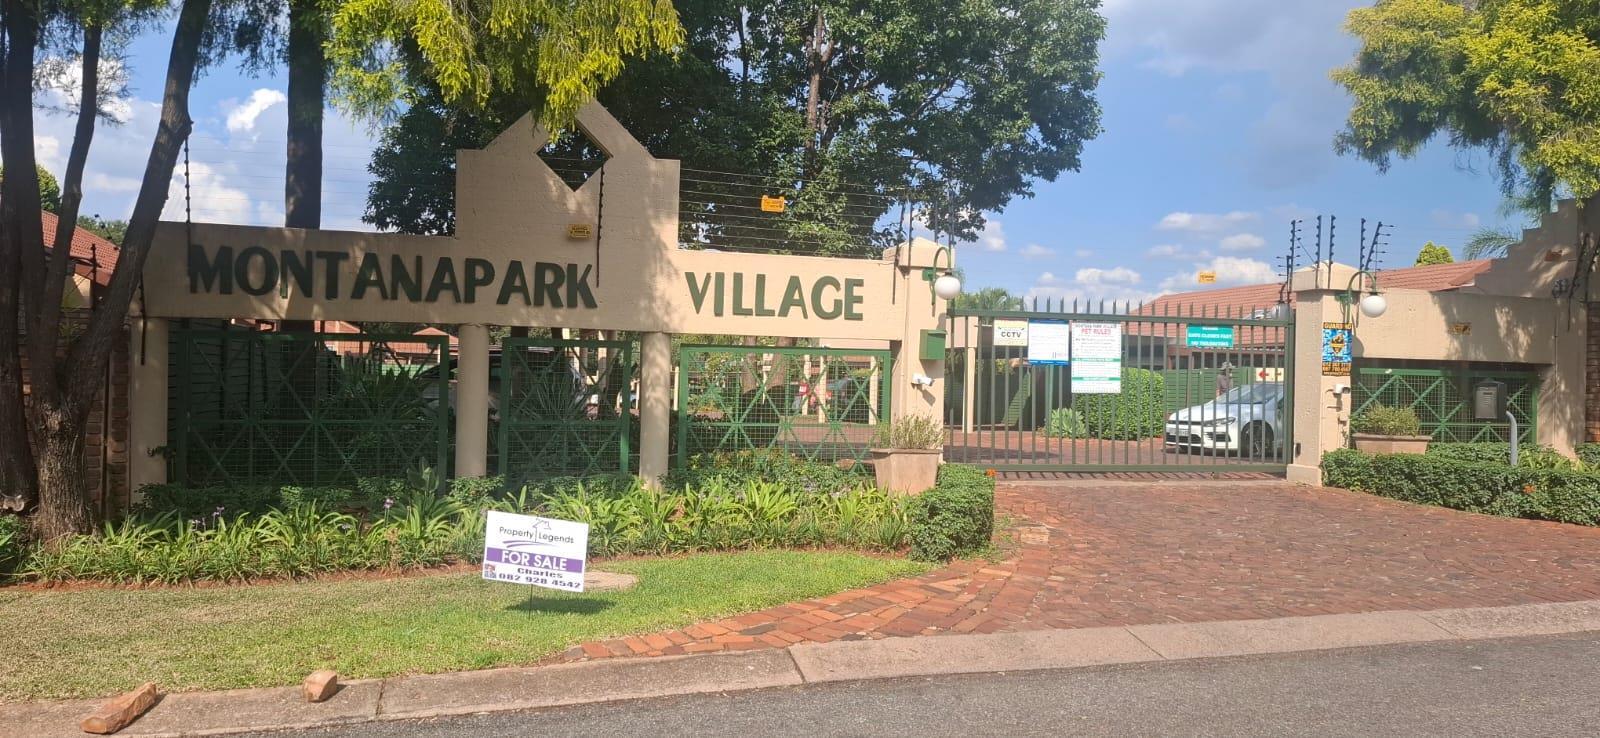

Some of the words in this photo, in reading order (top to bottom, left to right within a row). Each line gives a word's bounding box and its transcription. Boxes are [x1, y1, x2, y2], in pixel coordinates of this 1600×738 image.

[685, 272, 864, 321] VILLAGE
[500, 526, 534, 540] Property
[539, 532, 574, 544] Legends
[502, 550, 530, 566] FOR
[534, 555, 567, 571] SALE
[517, 568, 563, 579] Charles
